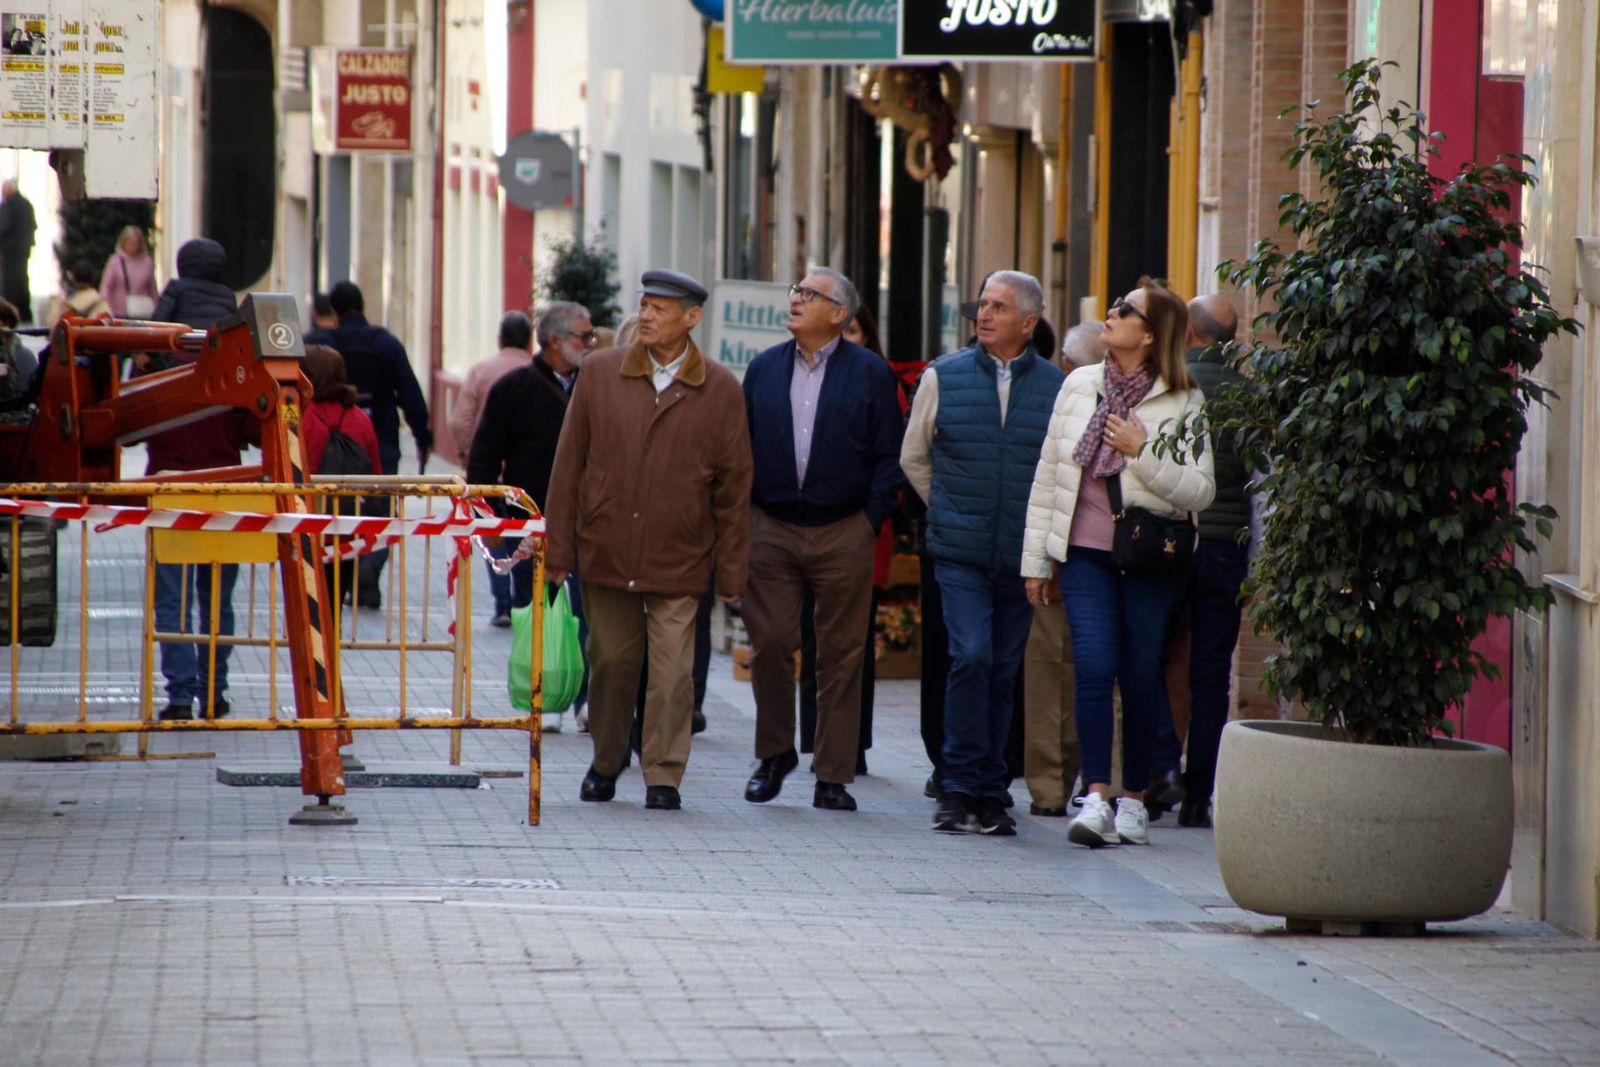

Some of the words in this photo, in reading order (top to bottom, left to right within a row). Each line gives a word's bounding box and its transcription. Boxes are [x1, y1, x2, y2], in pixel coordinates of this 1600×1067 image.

[738, 0, 897, 23] Hierbaluis
[939, 0, 1058, 32] JUSTO
[341, 83, 408, 106] JUSTO
[723, 300, 789, 326] Little
[273, 326, 290, 346] 2
